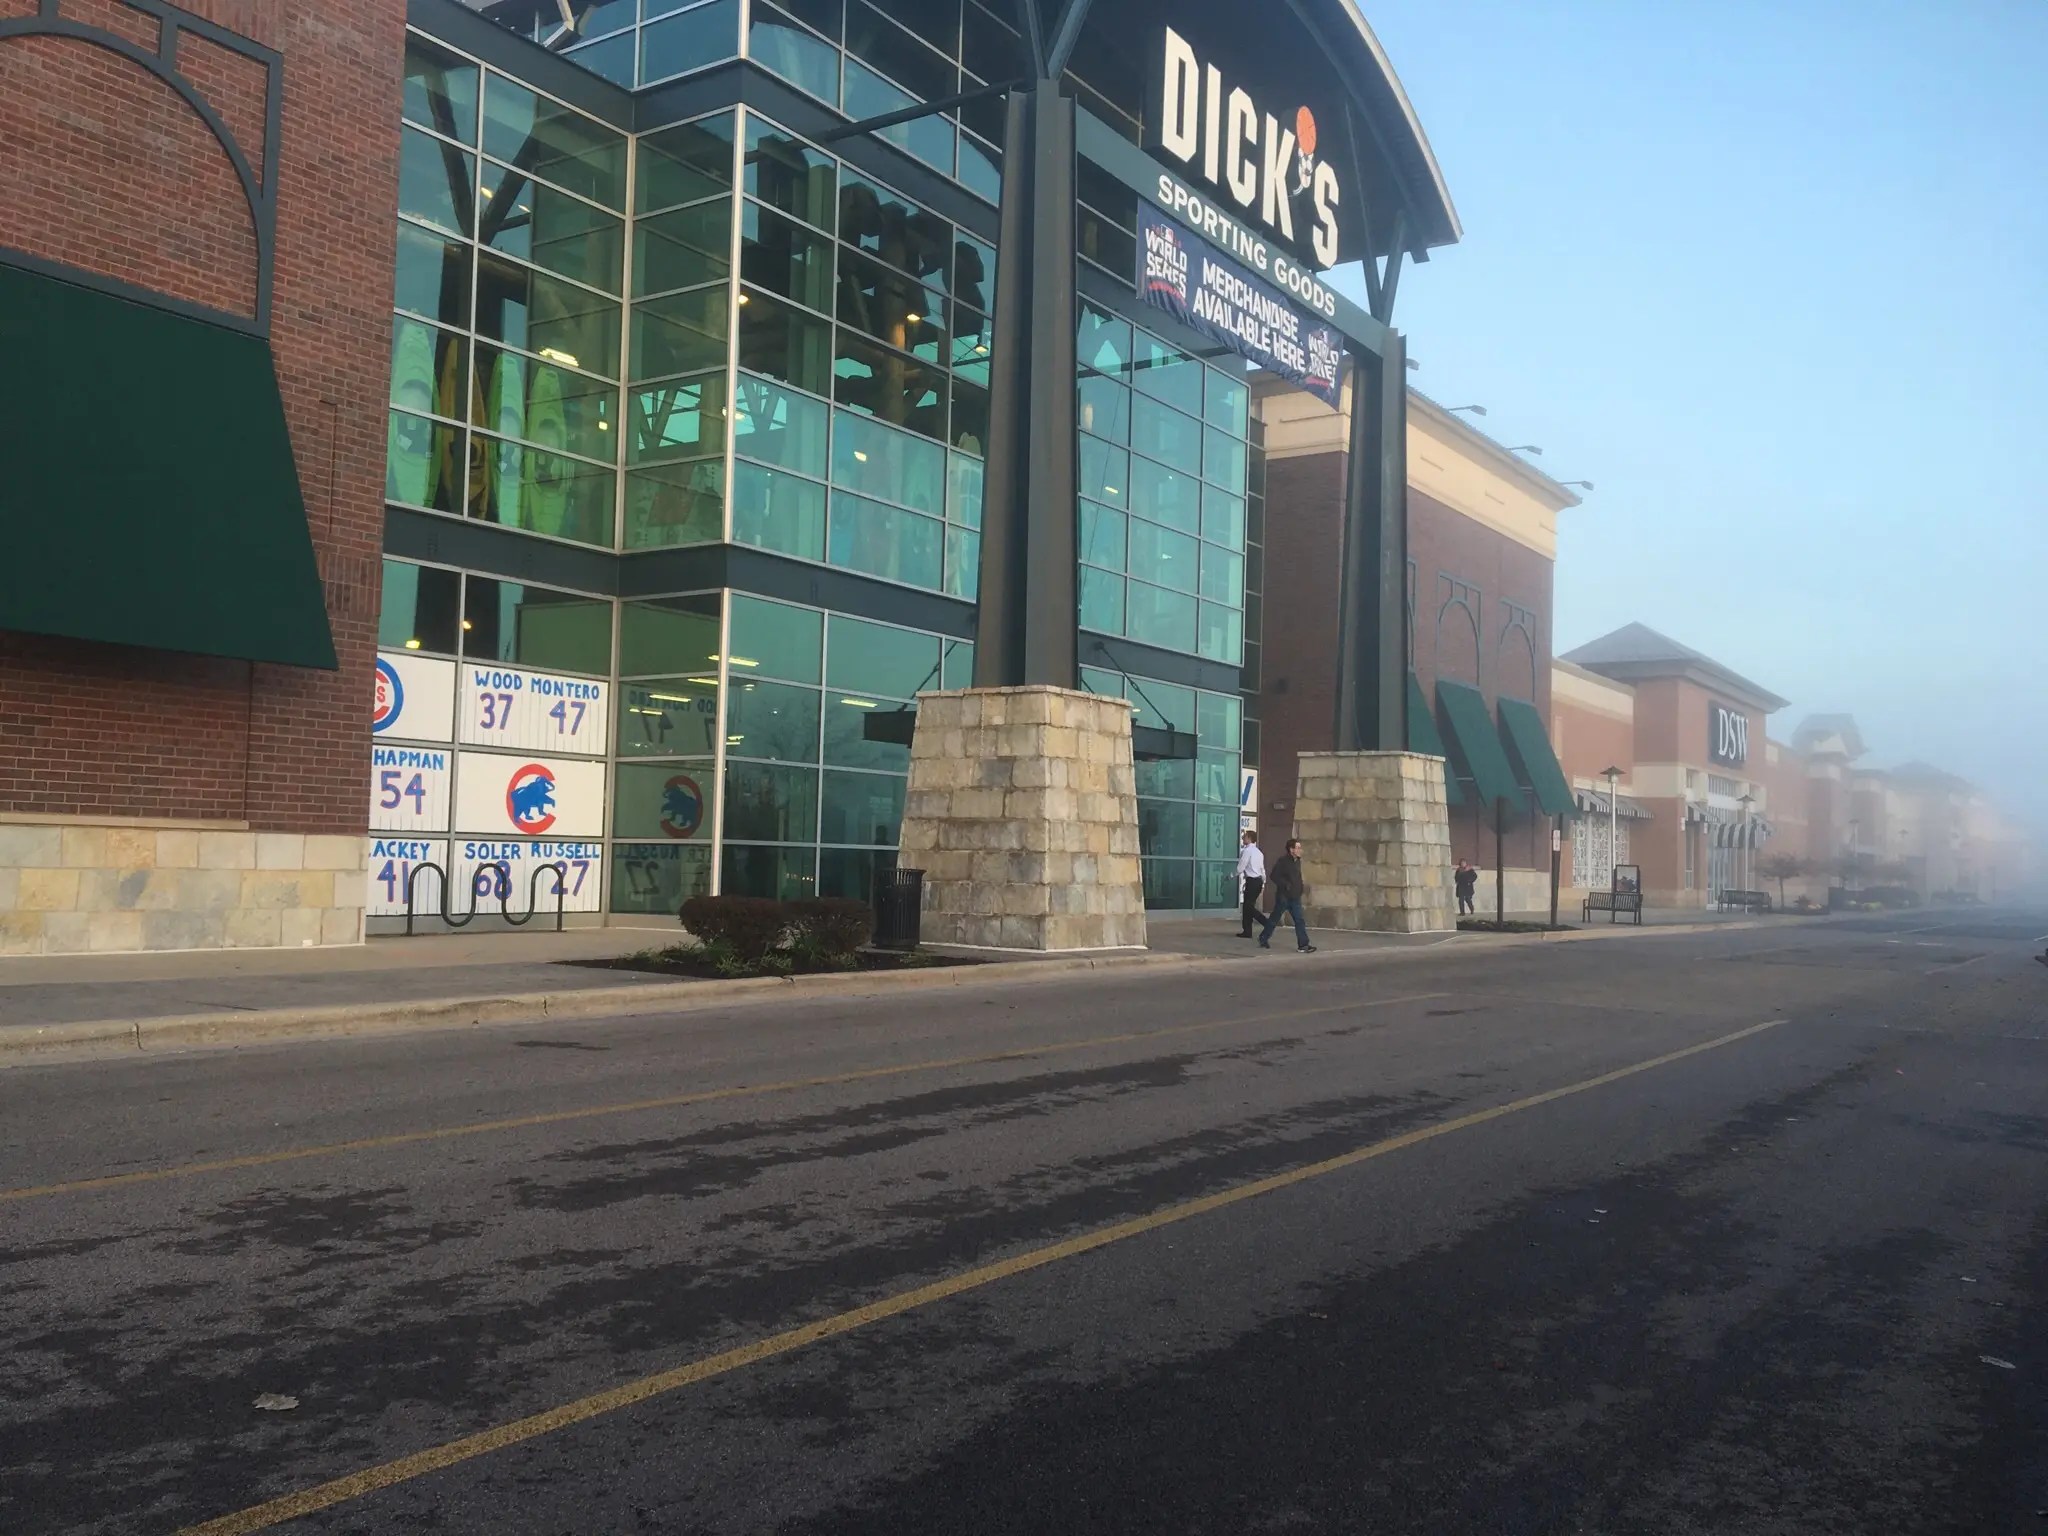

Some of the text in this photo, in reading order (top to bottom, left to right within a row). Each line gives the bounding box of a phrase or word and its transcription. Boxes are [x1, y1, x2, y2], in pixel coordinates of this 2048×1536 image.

[1162, 25, 1339, 269] DICK'S
[1145, 227, 1187, 273] WORLD
[1158, 174, 1336, 317] SPORTING GOODS
[1202, 256, 1299, 343] MERCHANDISE
[1192, 286, 1306, 373] AVAILABLE HERE
[474, 670, 600, 700] WOOD MONTERO
[479, 692, 587, 736] 37 47
[1718, 707, 1749, 761] DSW
[373, 748, 444, 771] HAPMAN
[379, 770, 426, 816] 54
[368, 840, 431, 861] ACKEY
[464, 841, 601, 860] SOLER RUSSELL
[376, 859, 409, 905] 41
[475, 860, 590, 901] 68 27
